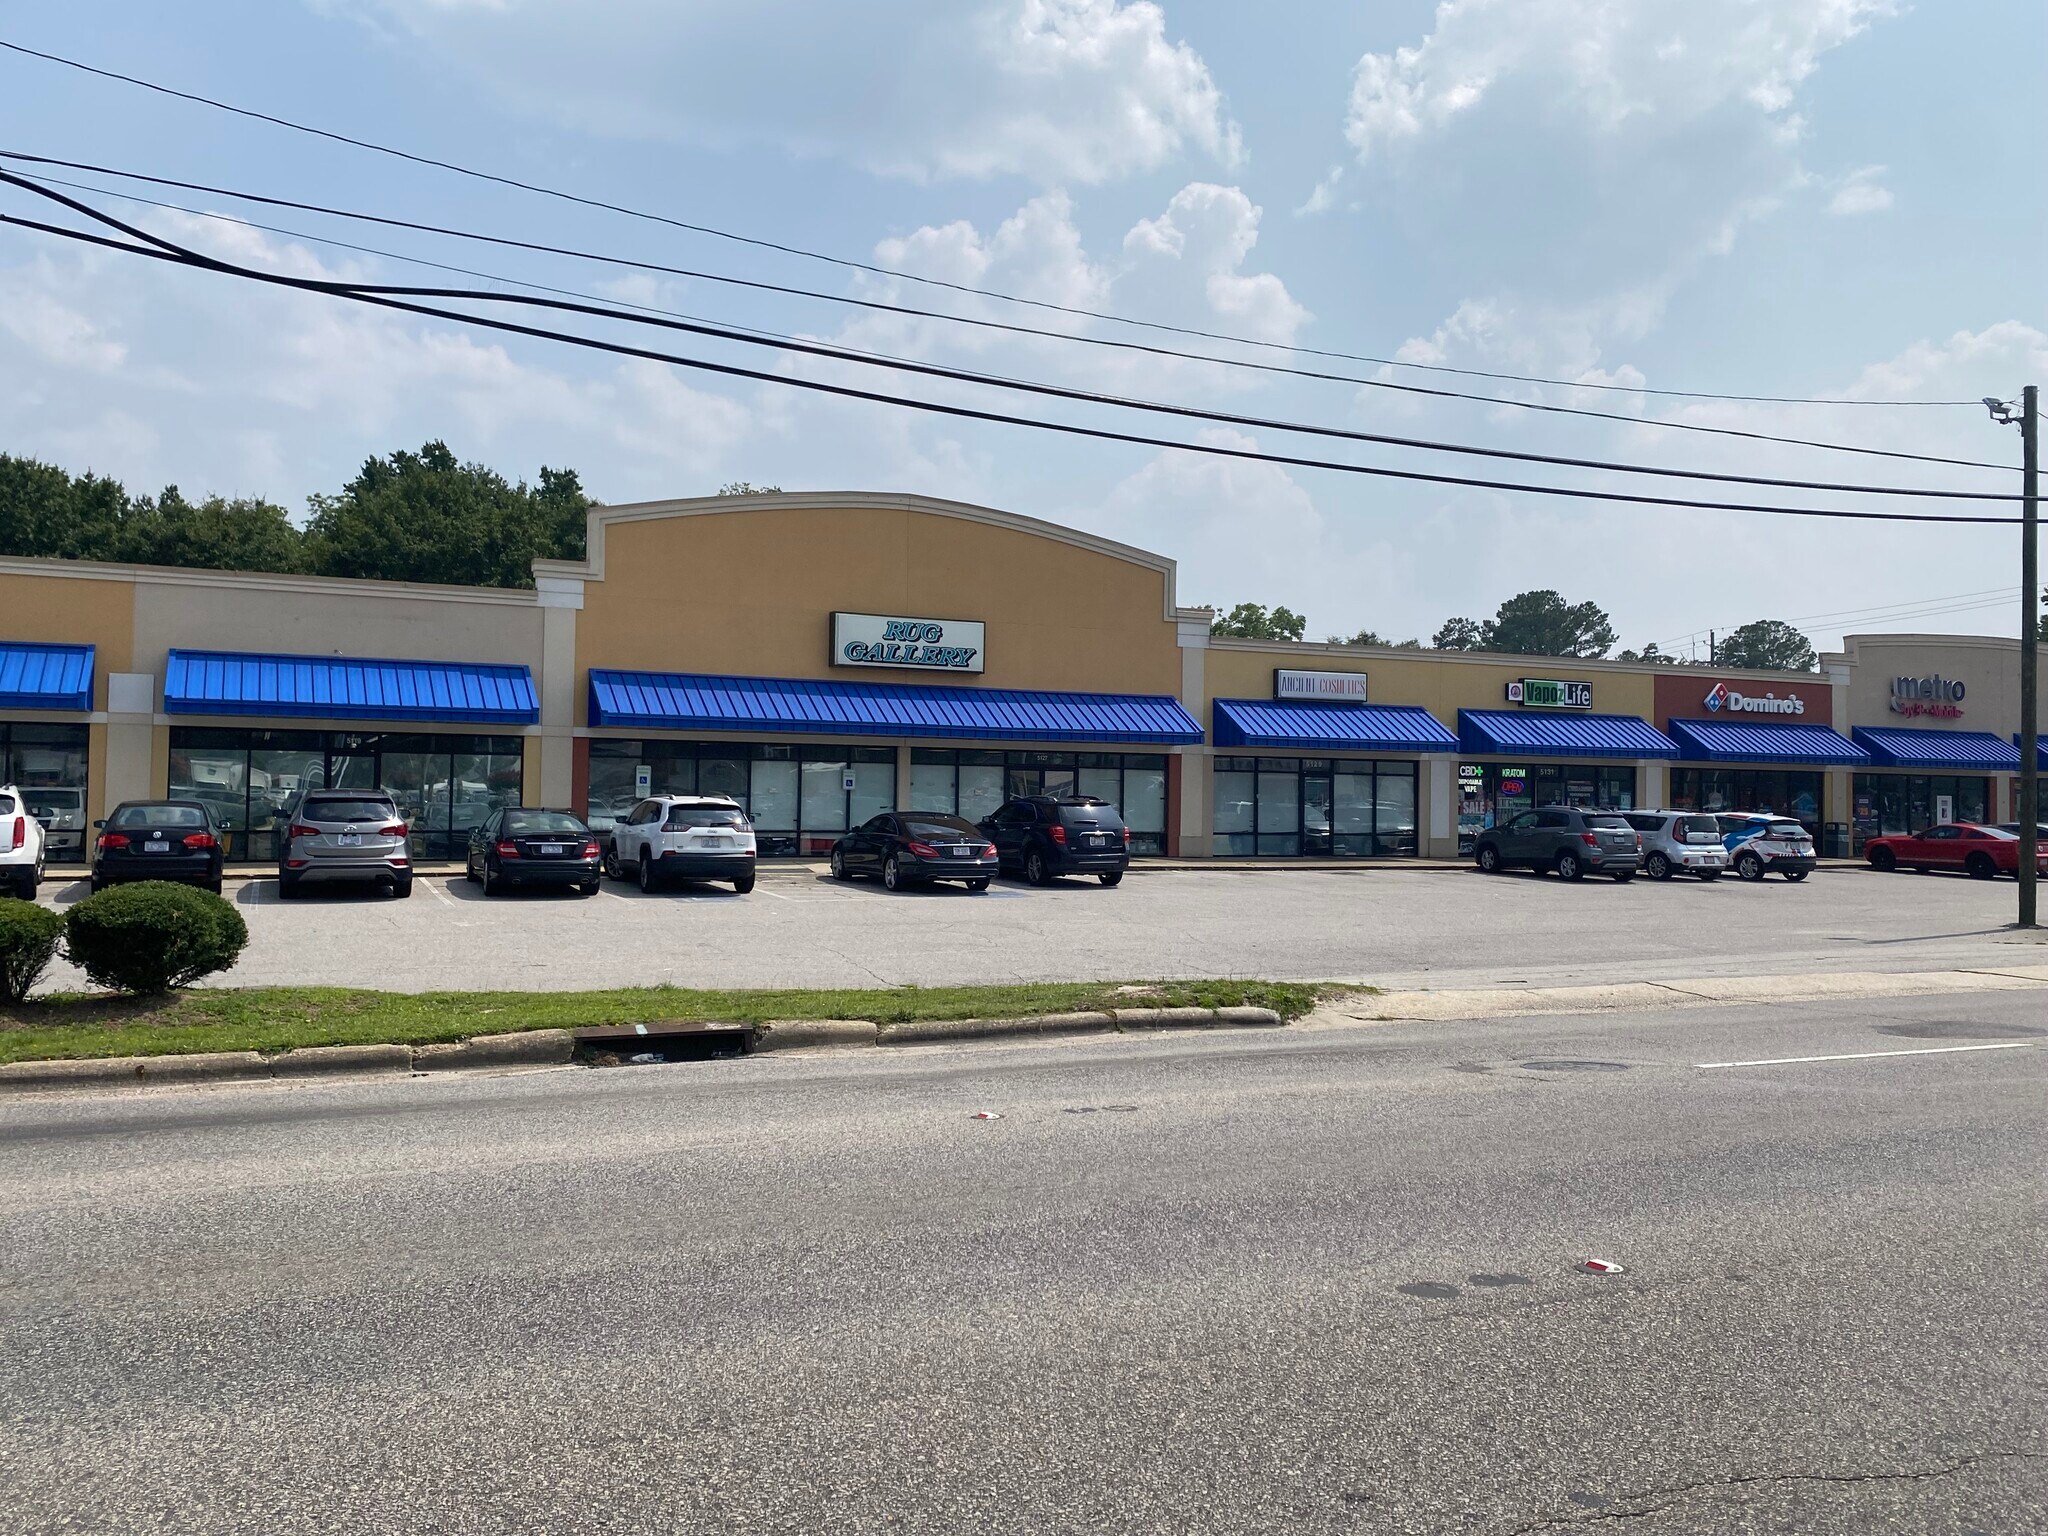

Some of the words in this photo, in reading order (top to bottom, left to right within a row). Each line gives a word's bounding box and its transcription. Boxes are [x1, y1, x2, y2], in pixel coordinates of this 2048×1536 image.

[882, 620, 943, 642] RUG
[844, 641, 976, 667] GALLERY
[1281, 677, 1315, 693] ANCIENT
[1319, 679, 1366, 695] COSMETICS
[1893, 673, 1965, 701] metro
[1727, 692, 1804, 714] Domino's
[1501, 768, 1526, 778] KRATOM
[1540, 768, 1555, 776] 5131
[1464, 785, 1477, 793] VAPE
[1503, 781, 1522, 793] OPEN
[1463, 801, 1485, 814] SALE
